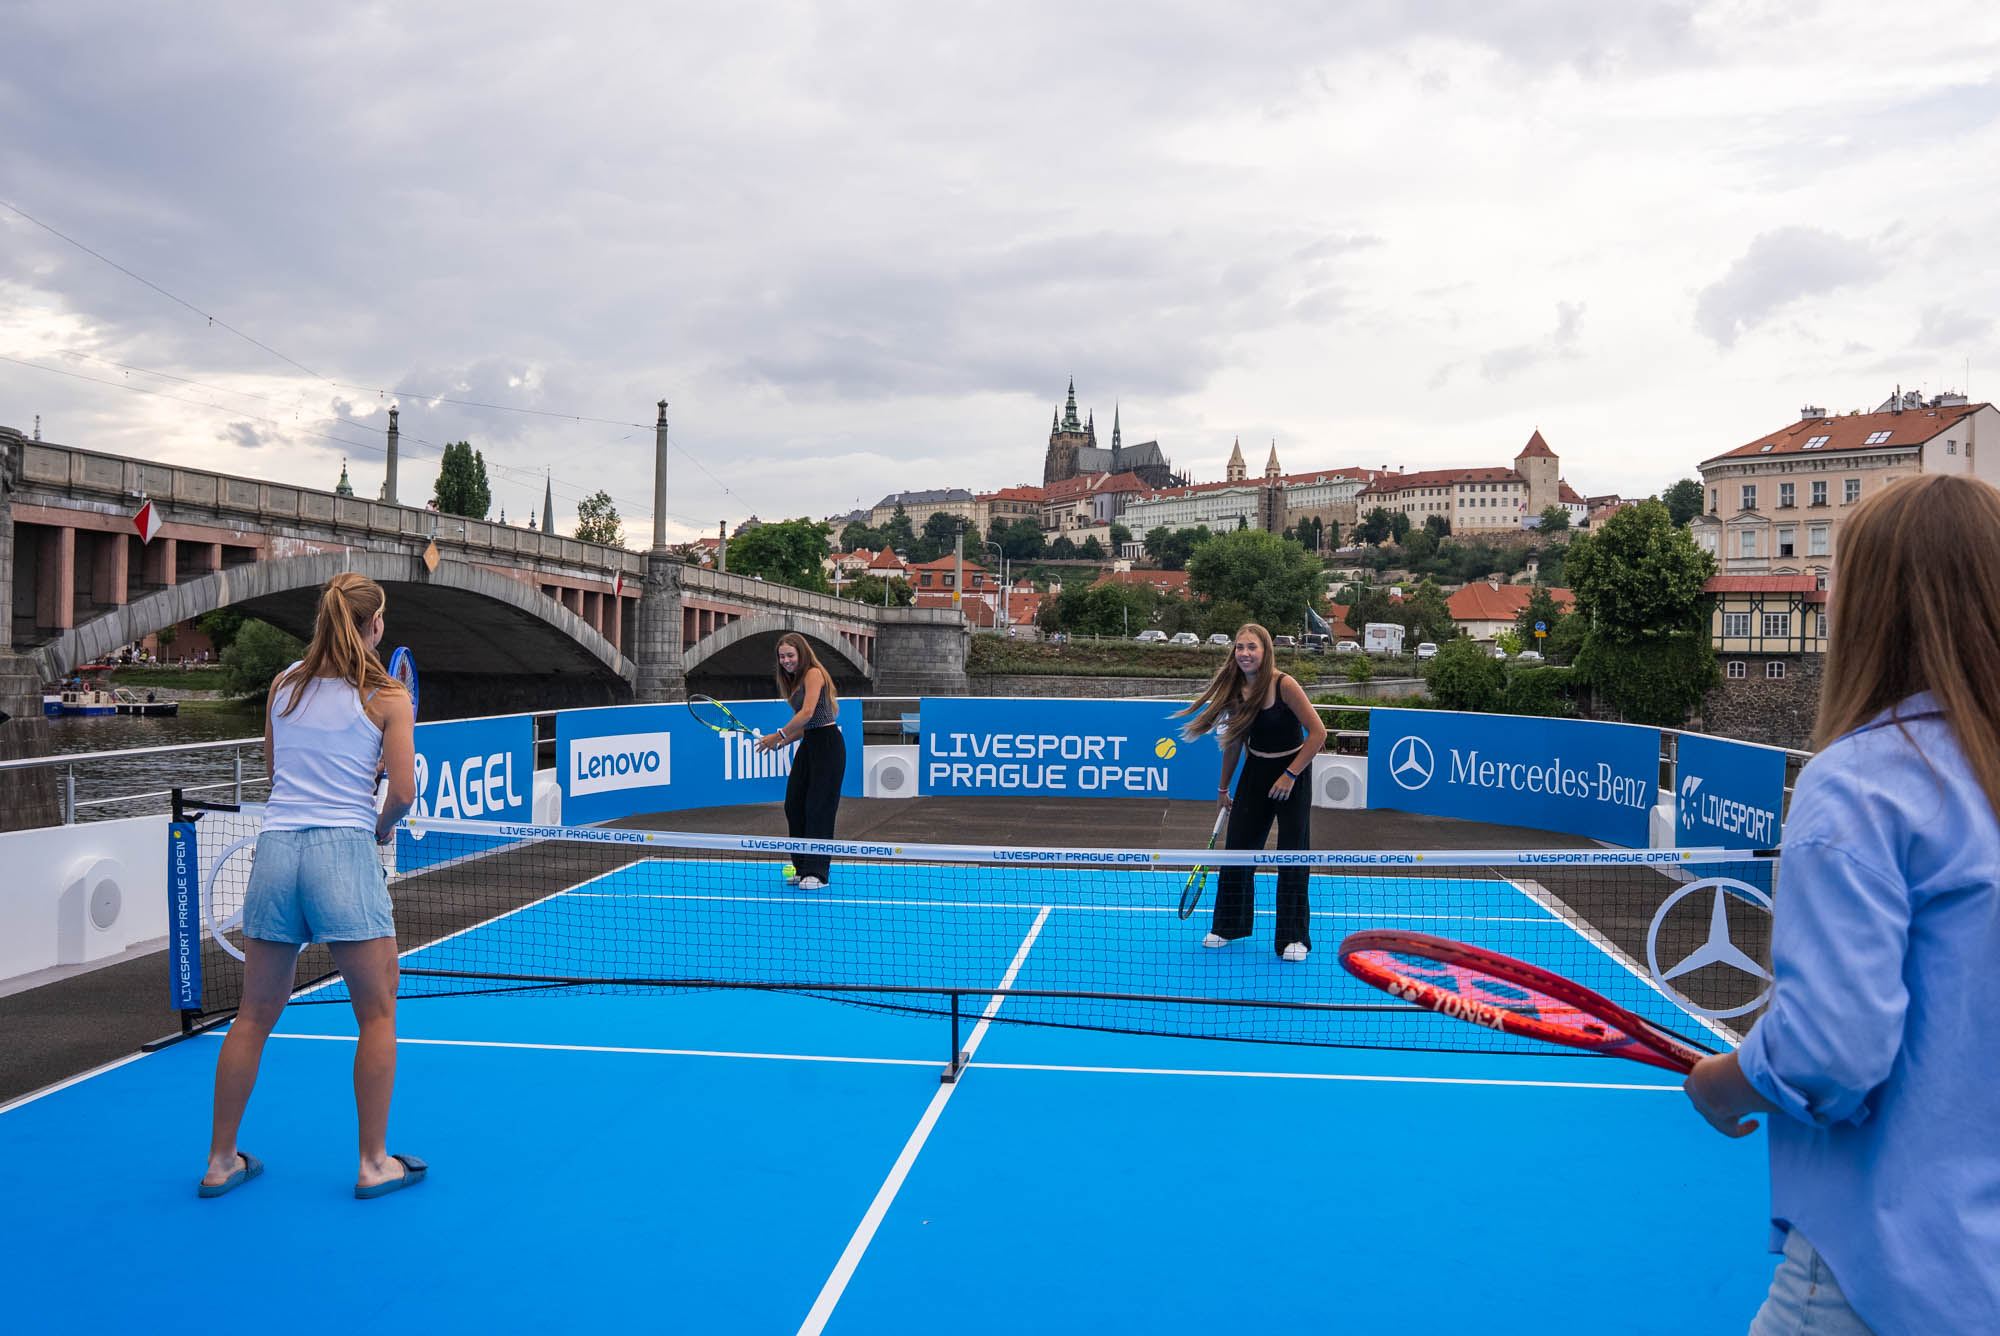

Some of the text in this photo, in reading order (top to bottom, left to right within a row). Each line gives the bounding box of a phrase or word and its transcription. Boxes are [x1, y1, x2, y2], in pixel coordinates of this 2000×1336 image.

[930, 733, 1128, 761] LIVESPORT
[577, 750, 660, 781] Lenovo
[929, 762, 1168, 792] PRAGUE OPEN
[1447, 749, 1647, 810] Mercedes-Benz
[433, 751, 522, 820] AGEL
[500, 826, 645, 843] LIVESPORT PRAGUE OPEN
[1701, 794, 1775, 845] LIVESPORT
[741, 839, 892, 856] LIVESPORT PRAGUE OPEN
[993, 850, 1150, 862] LIVESPORT PRAGUE OPEN
[1253, 854, 1413, 864] LIVESPORT PRAGUE OPEN
[1518, 852, 1680, 863] LIVESPORT PRAGUE OPEN
[176, 841, 192, 1002] LIVESPORT PRAGUE OPEN
[1432, 989, 1505, 1031] YONEX
